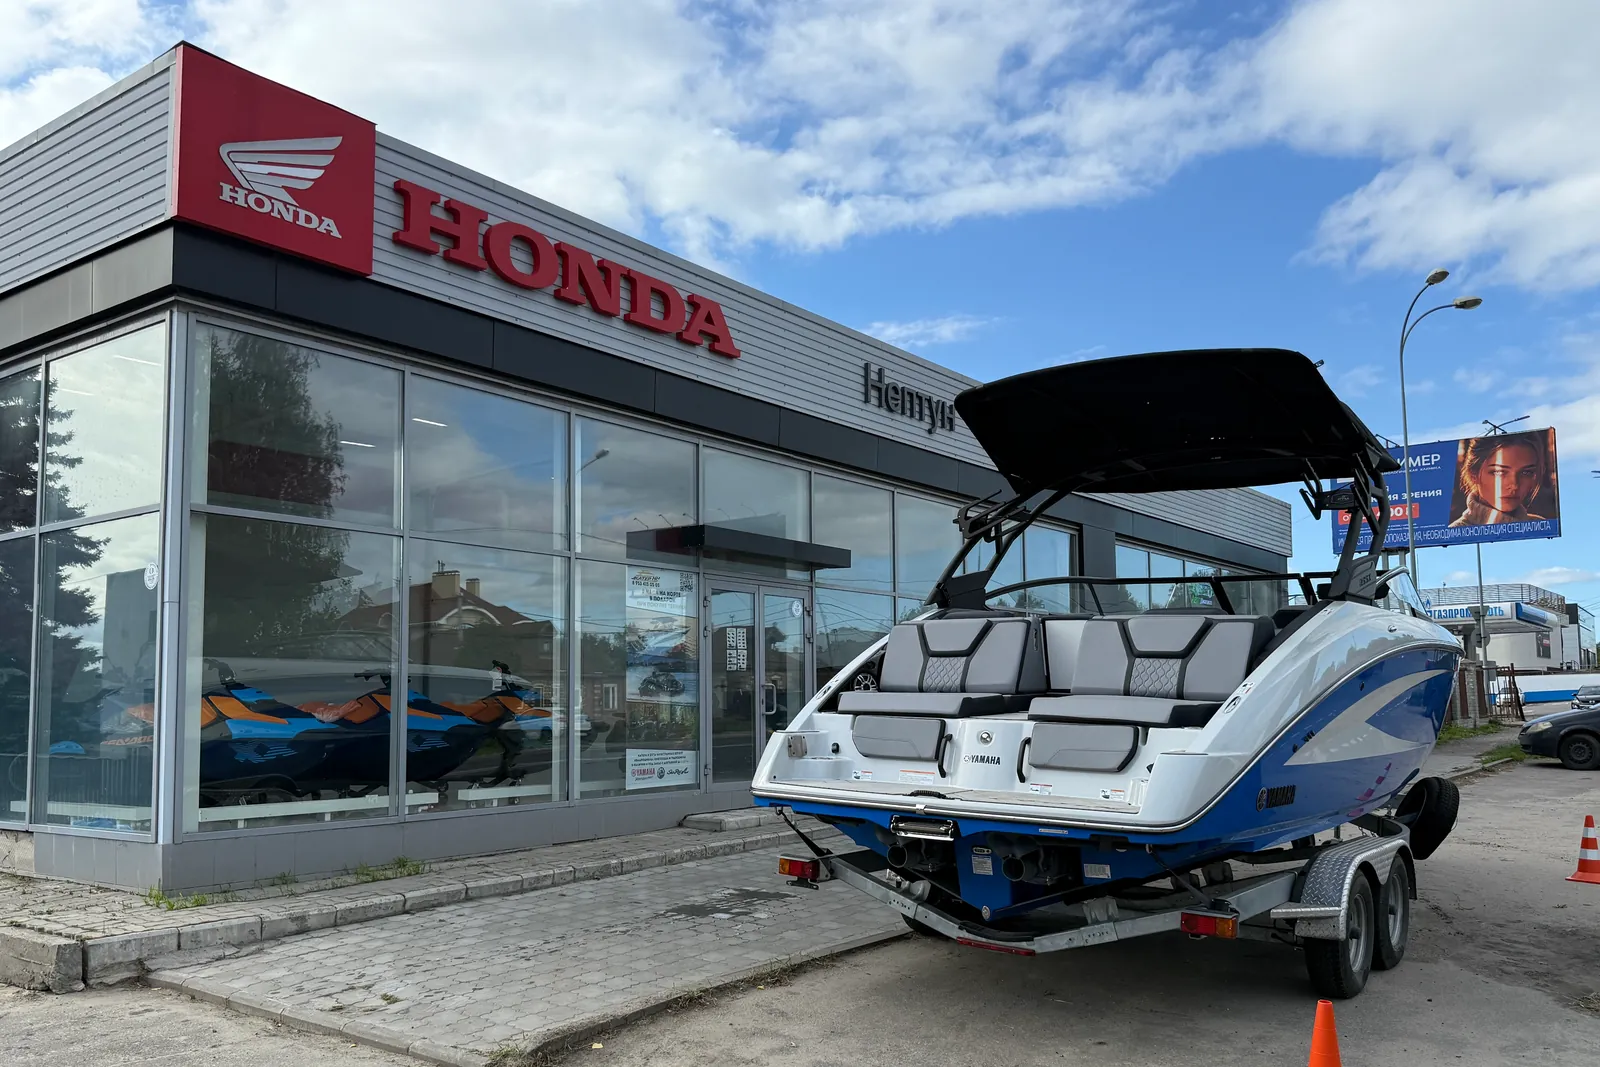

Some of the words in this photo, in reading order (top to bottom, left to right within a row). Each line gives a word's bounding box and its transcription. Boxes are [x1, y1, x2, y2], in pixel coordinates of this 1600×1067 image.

[219, 182, 342, 239] HONDA
[393, 179, 741, 359] HONDA
[864, 362, 956, 434] Нептун
[1397, 453, 1441, 468] ИМЕР
[1423, 527, 1461, 540] НЕОБХОДИМА
[1461, 523, 1507, 537] КОНСУЛЬТАЦИЯ
[1507, 520, 1551, 534] СПЕЦИАЛИСТА
[971, 755, 1001, 765] YAMAHA
[1266, 785, 1296, 808] YAMAHA
